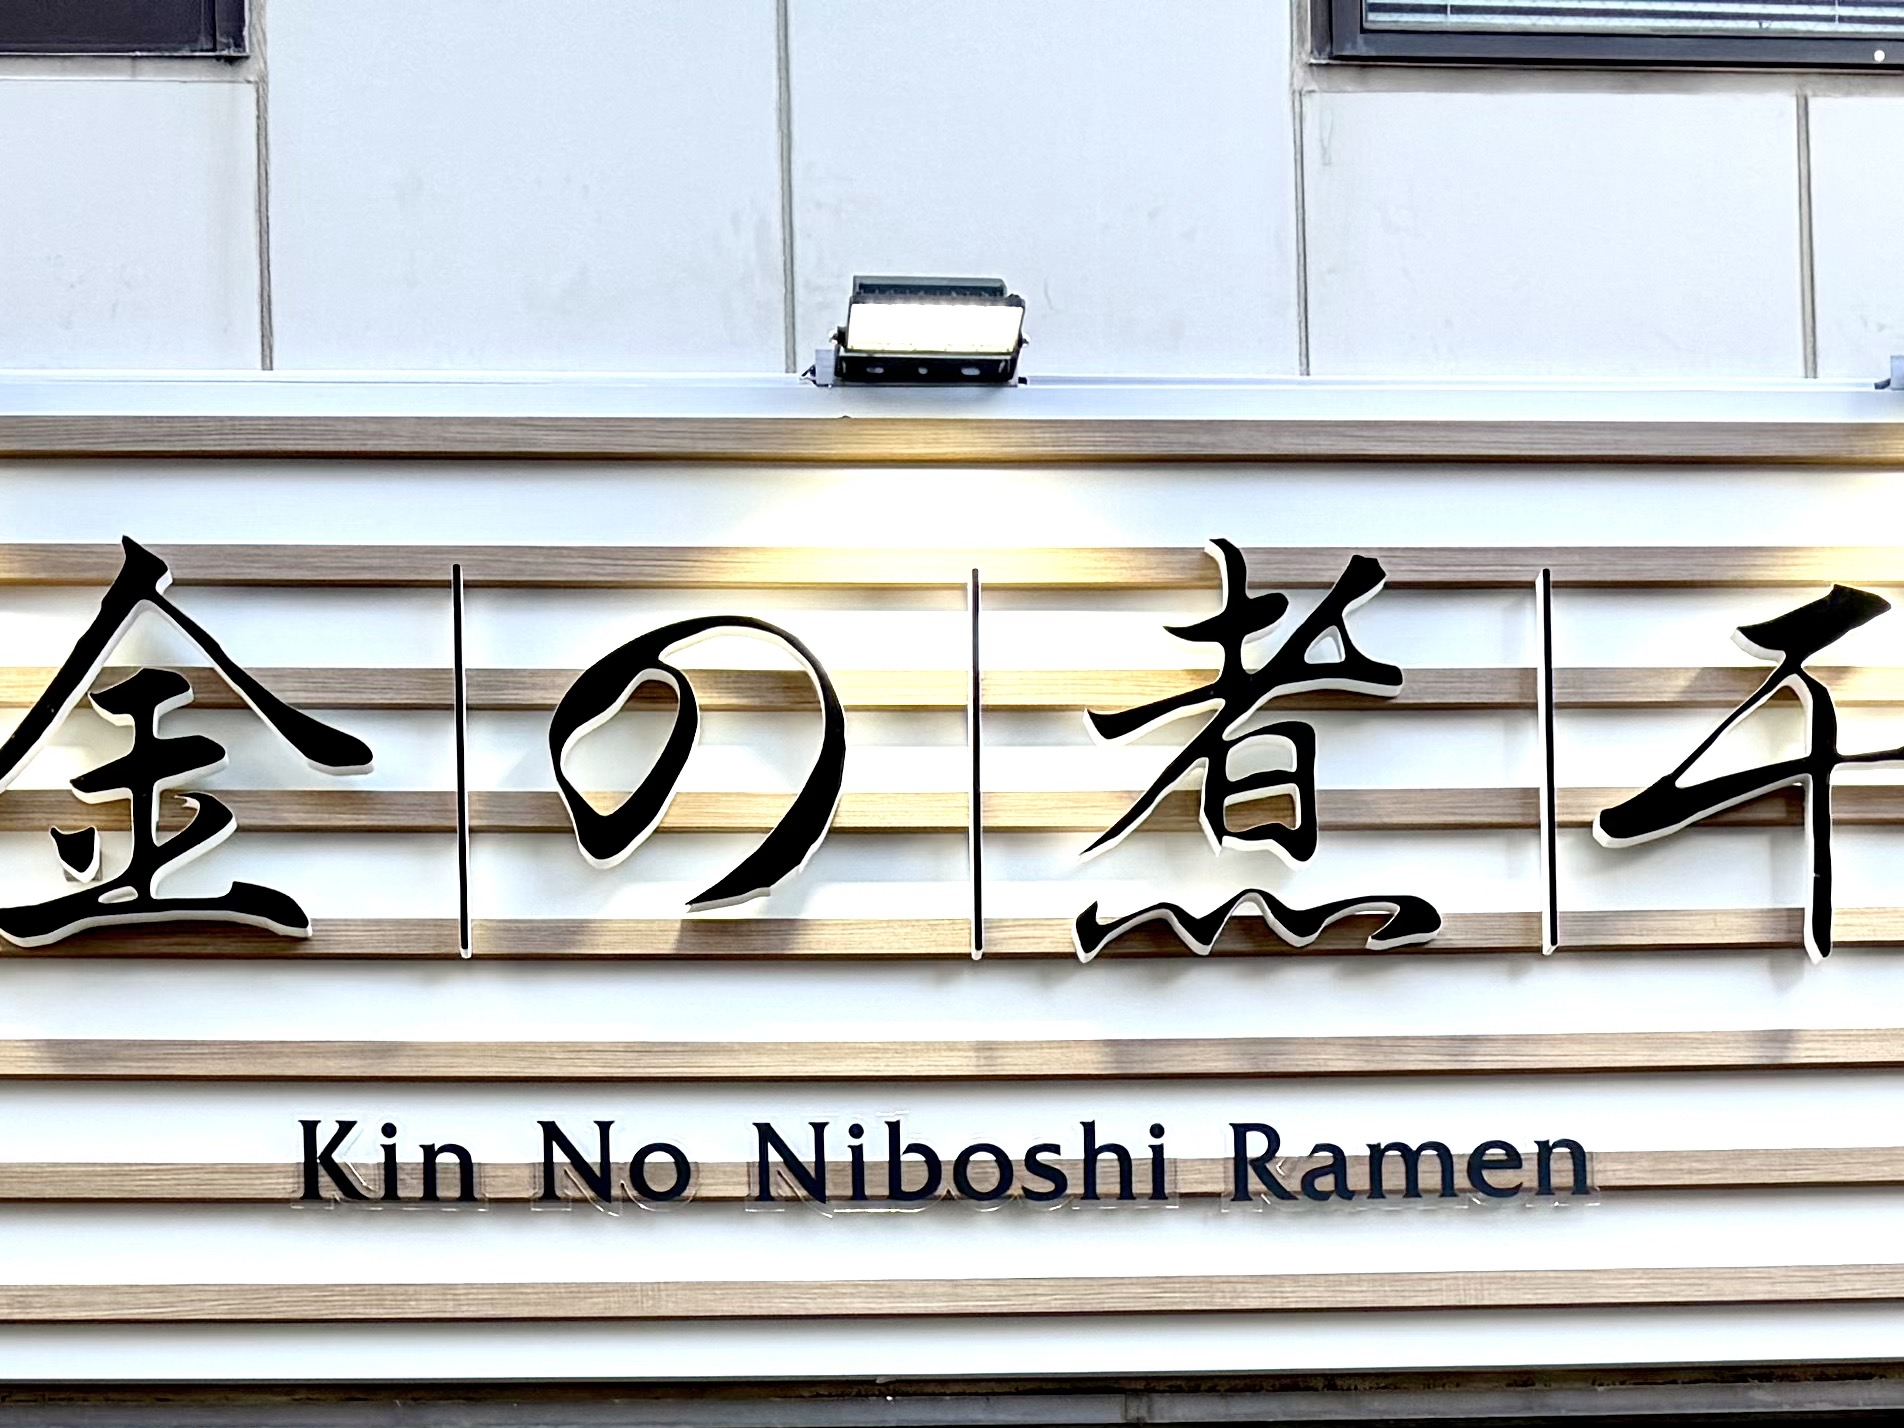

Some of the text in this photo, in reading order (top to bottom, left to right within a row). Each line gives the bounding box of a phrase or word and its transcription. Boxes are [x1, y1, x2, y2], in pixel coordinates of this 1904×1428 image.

[297, 1118, 1593, 1205] Kin No Niboshi Ramen
